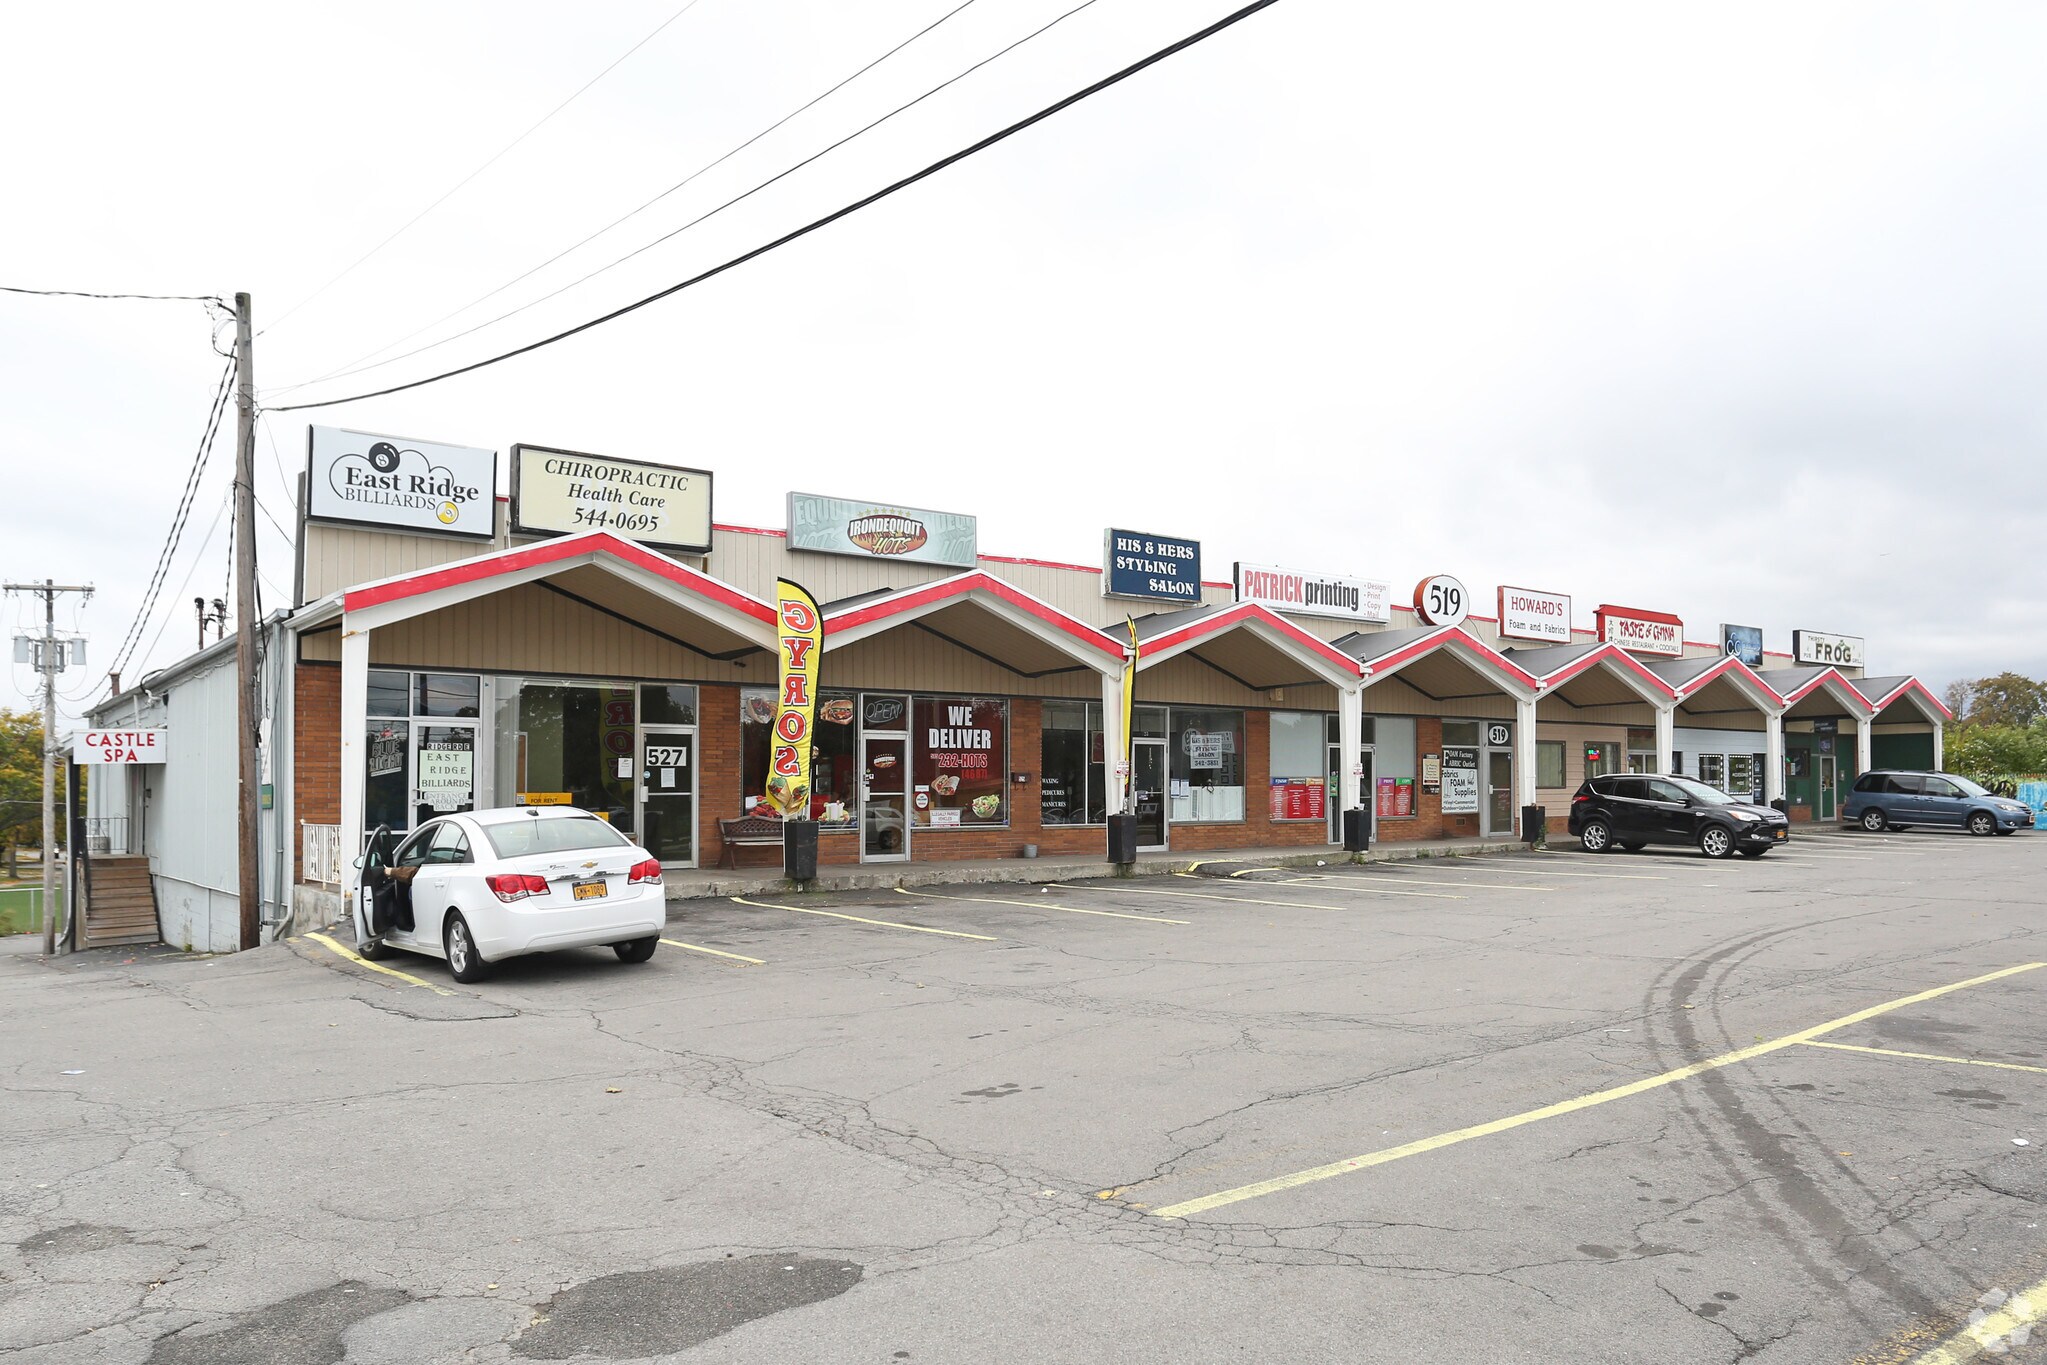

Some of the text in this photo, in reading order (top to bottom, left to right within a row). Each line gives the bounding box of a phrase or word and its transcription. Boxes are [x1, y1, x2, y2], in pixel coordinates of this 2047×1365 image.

[545, 458, 689, 491] CHIROPRACTIC
[345, 466, 479, 503] East Ridge
[344, 487, 436, 511] BILLIARDS
[567, 483, 665, 508] Health Care
[850, 517, 923, 537] IRONDEQUOIT
[872, 537, 913, 554] HOTS
[1117, 537, 1194, 560] HIS & HERS
[1116, 555, 1177, 576] STYLING
[1149, 578, 1194, 595] SALON
[1244, 570, 1359, 612] PATRICK printing
[1367, 582, 1387, 593] Design
[1367, 591, 1381, 600] Print
[1431, 585, 1461, 616] 519
[1367, 601, 1381, 611] Copy
[1511, 596, 1563, 617] HOWARD'S
[1509, 619, 1566, 635] Foam and Fabrics
[1619, 620, 1645, 639] TASTE
[1653, 625, 1675, 642] CHINA
[1614, 638, 1630, 646] CHINESE
[1632, 641, 1655, 650] RESTAURANT
[1815, 643, 1851, 663] FROG
[865, 702, 901, 719] OPEN
[948, 706, 972, 726] WE
[86, 733, 155, 747] CASTLE
[929, 728, 991, 749] DELIVER
[1492, 728, 1506, 741] 519
[104, 749, 138, 762] SPA
[427, 753, 460, 762] EAST
[648, 749, 683, 766] 527
[938, 753, 988, 768] 232-HOTS
[430, 766, 467, 774] RIDGE
[421, 779, 471, 788] BILLIARDS
[1450, 778, 1466, 787] FOAM
[1454, 788, 1477, 798] Supplies
